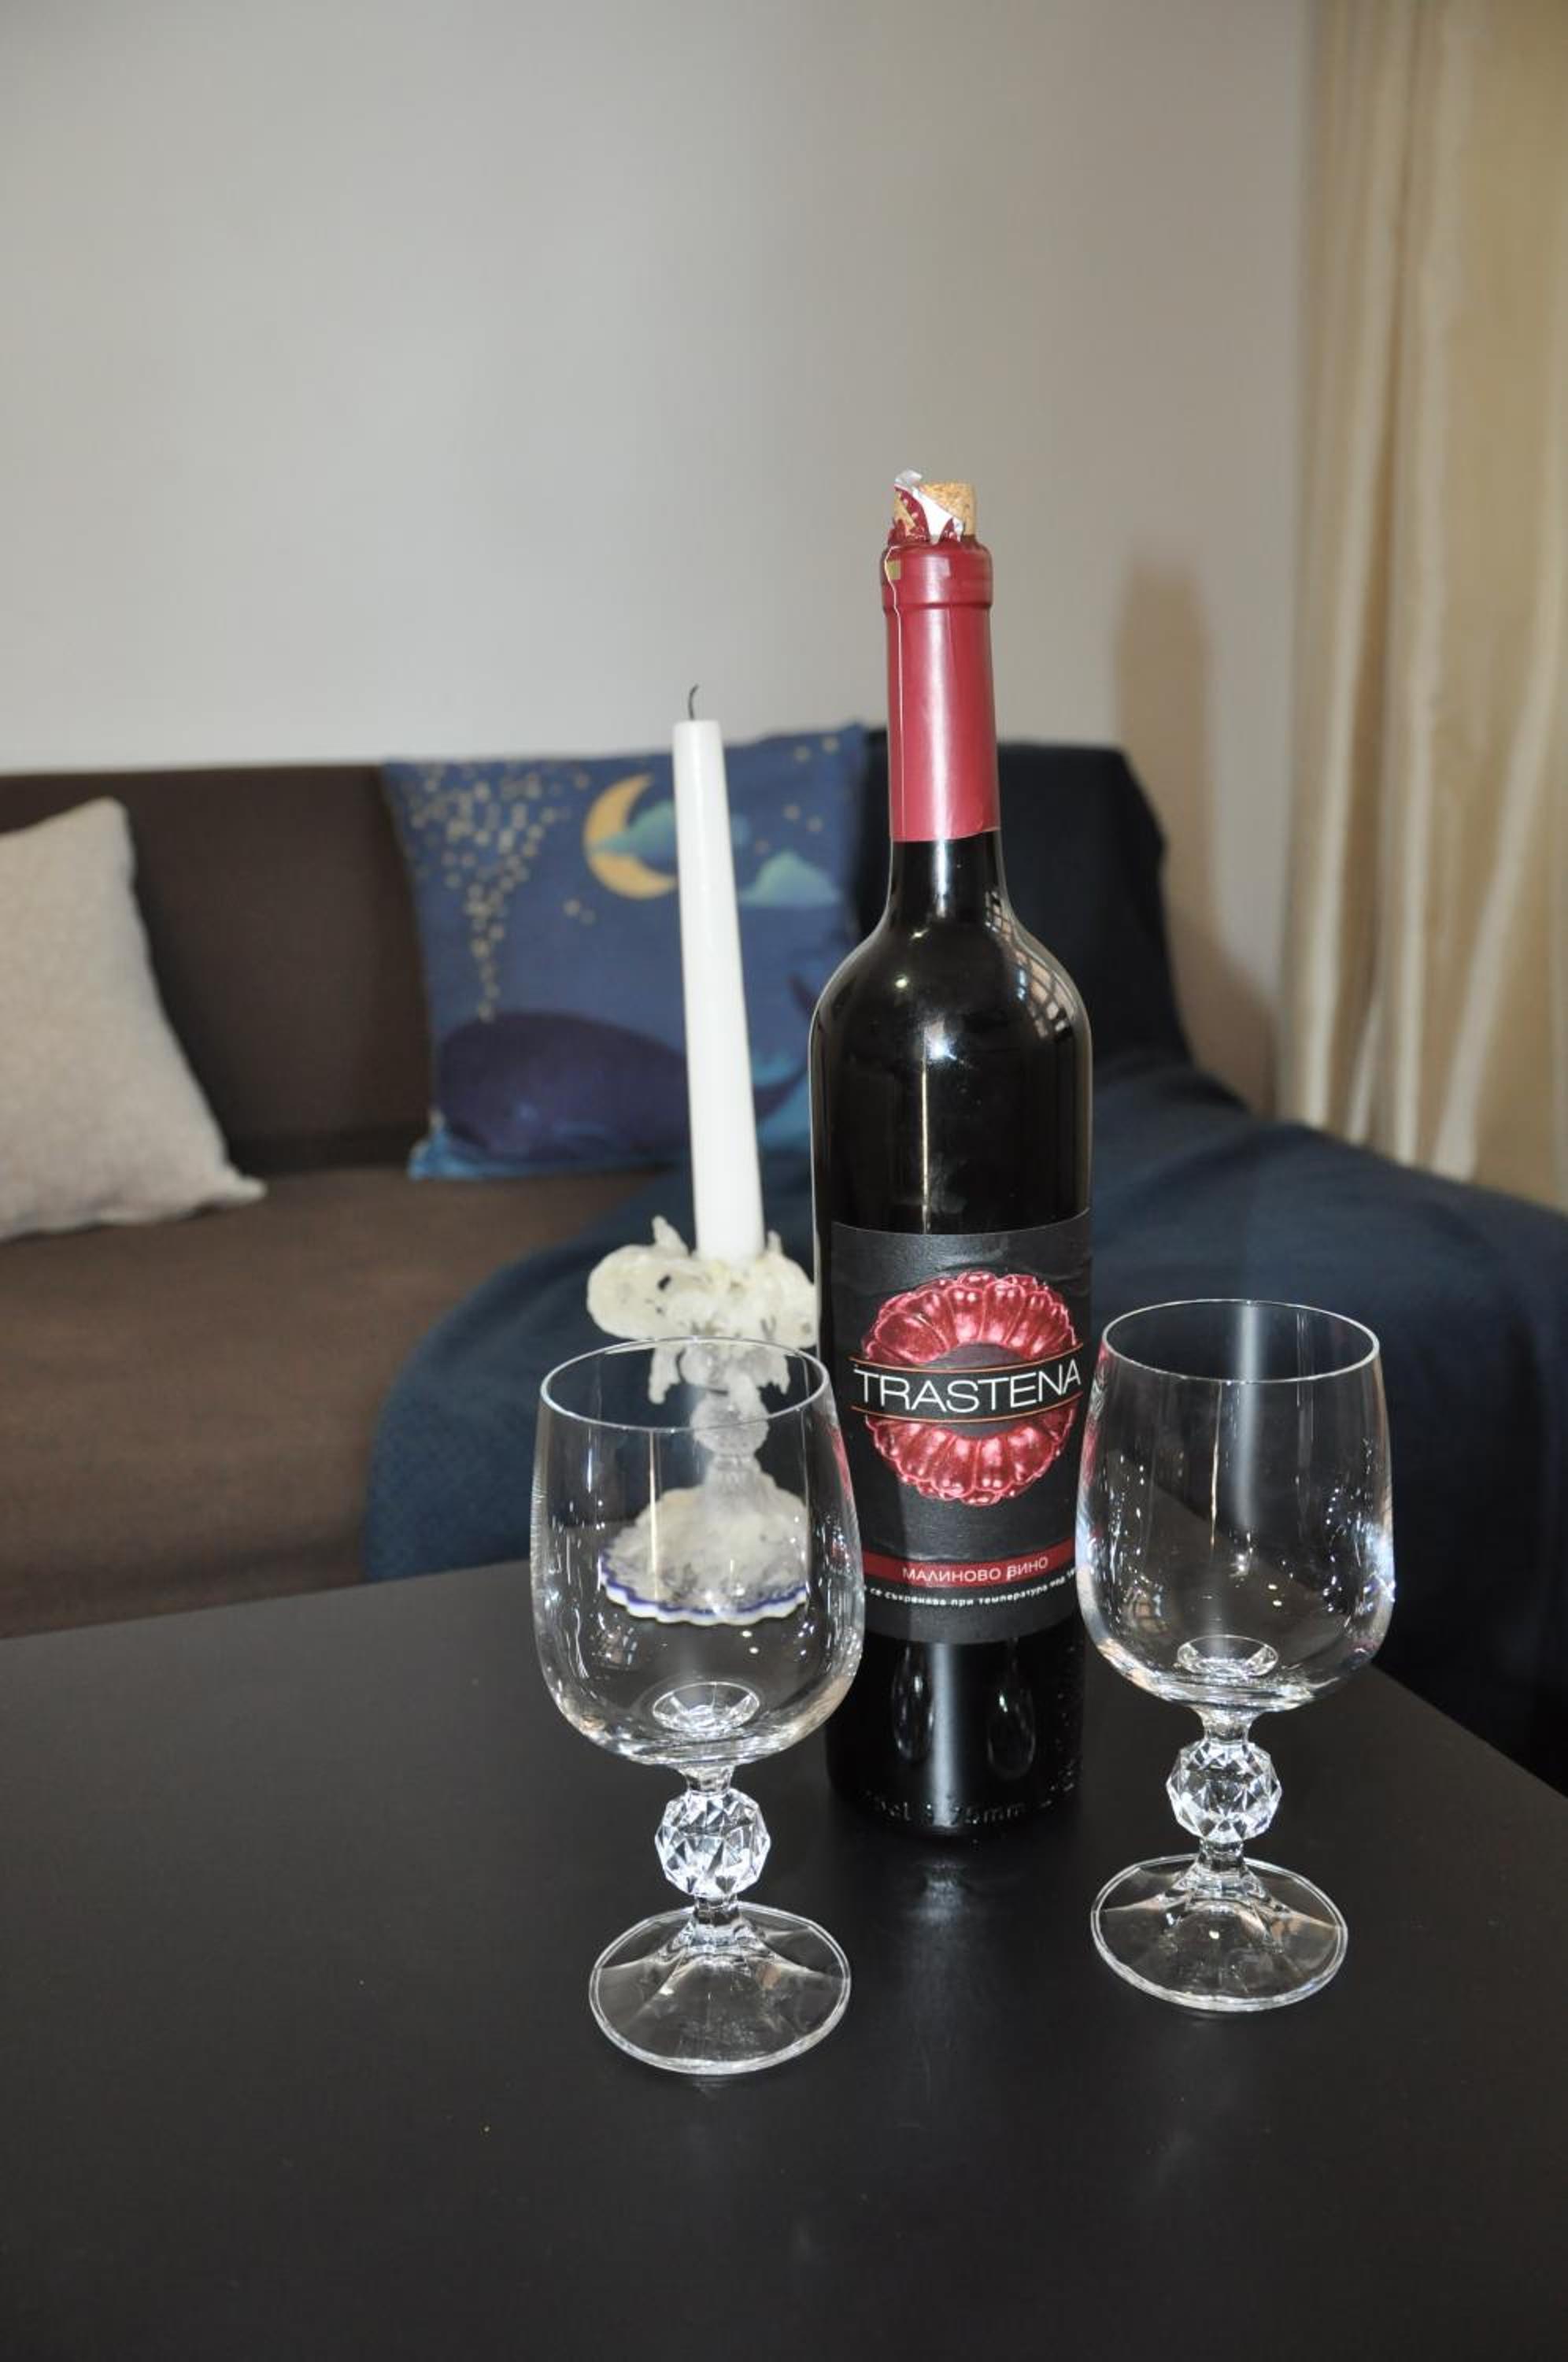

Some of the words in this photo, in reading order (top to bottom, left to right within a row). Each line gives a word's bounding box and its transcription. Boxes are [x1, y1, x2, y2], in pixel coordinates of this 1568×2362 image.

[853, 1358, 1082, 1414] TRASTENA
[902, 1568, 1001, 1583] МАЛИНОВО
[1006, 1556, 1048, 1581] ВИНО
[978, 1584, 1048, 1604] температура
